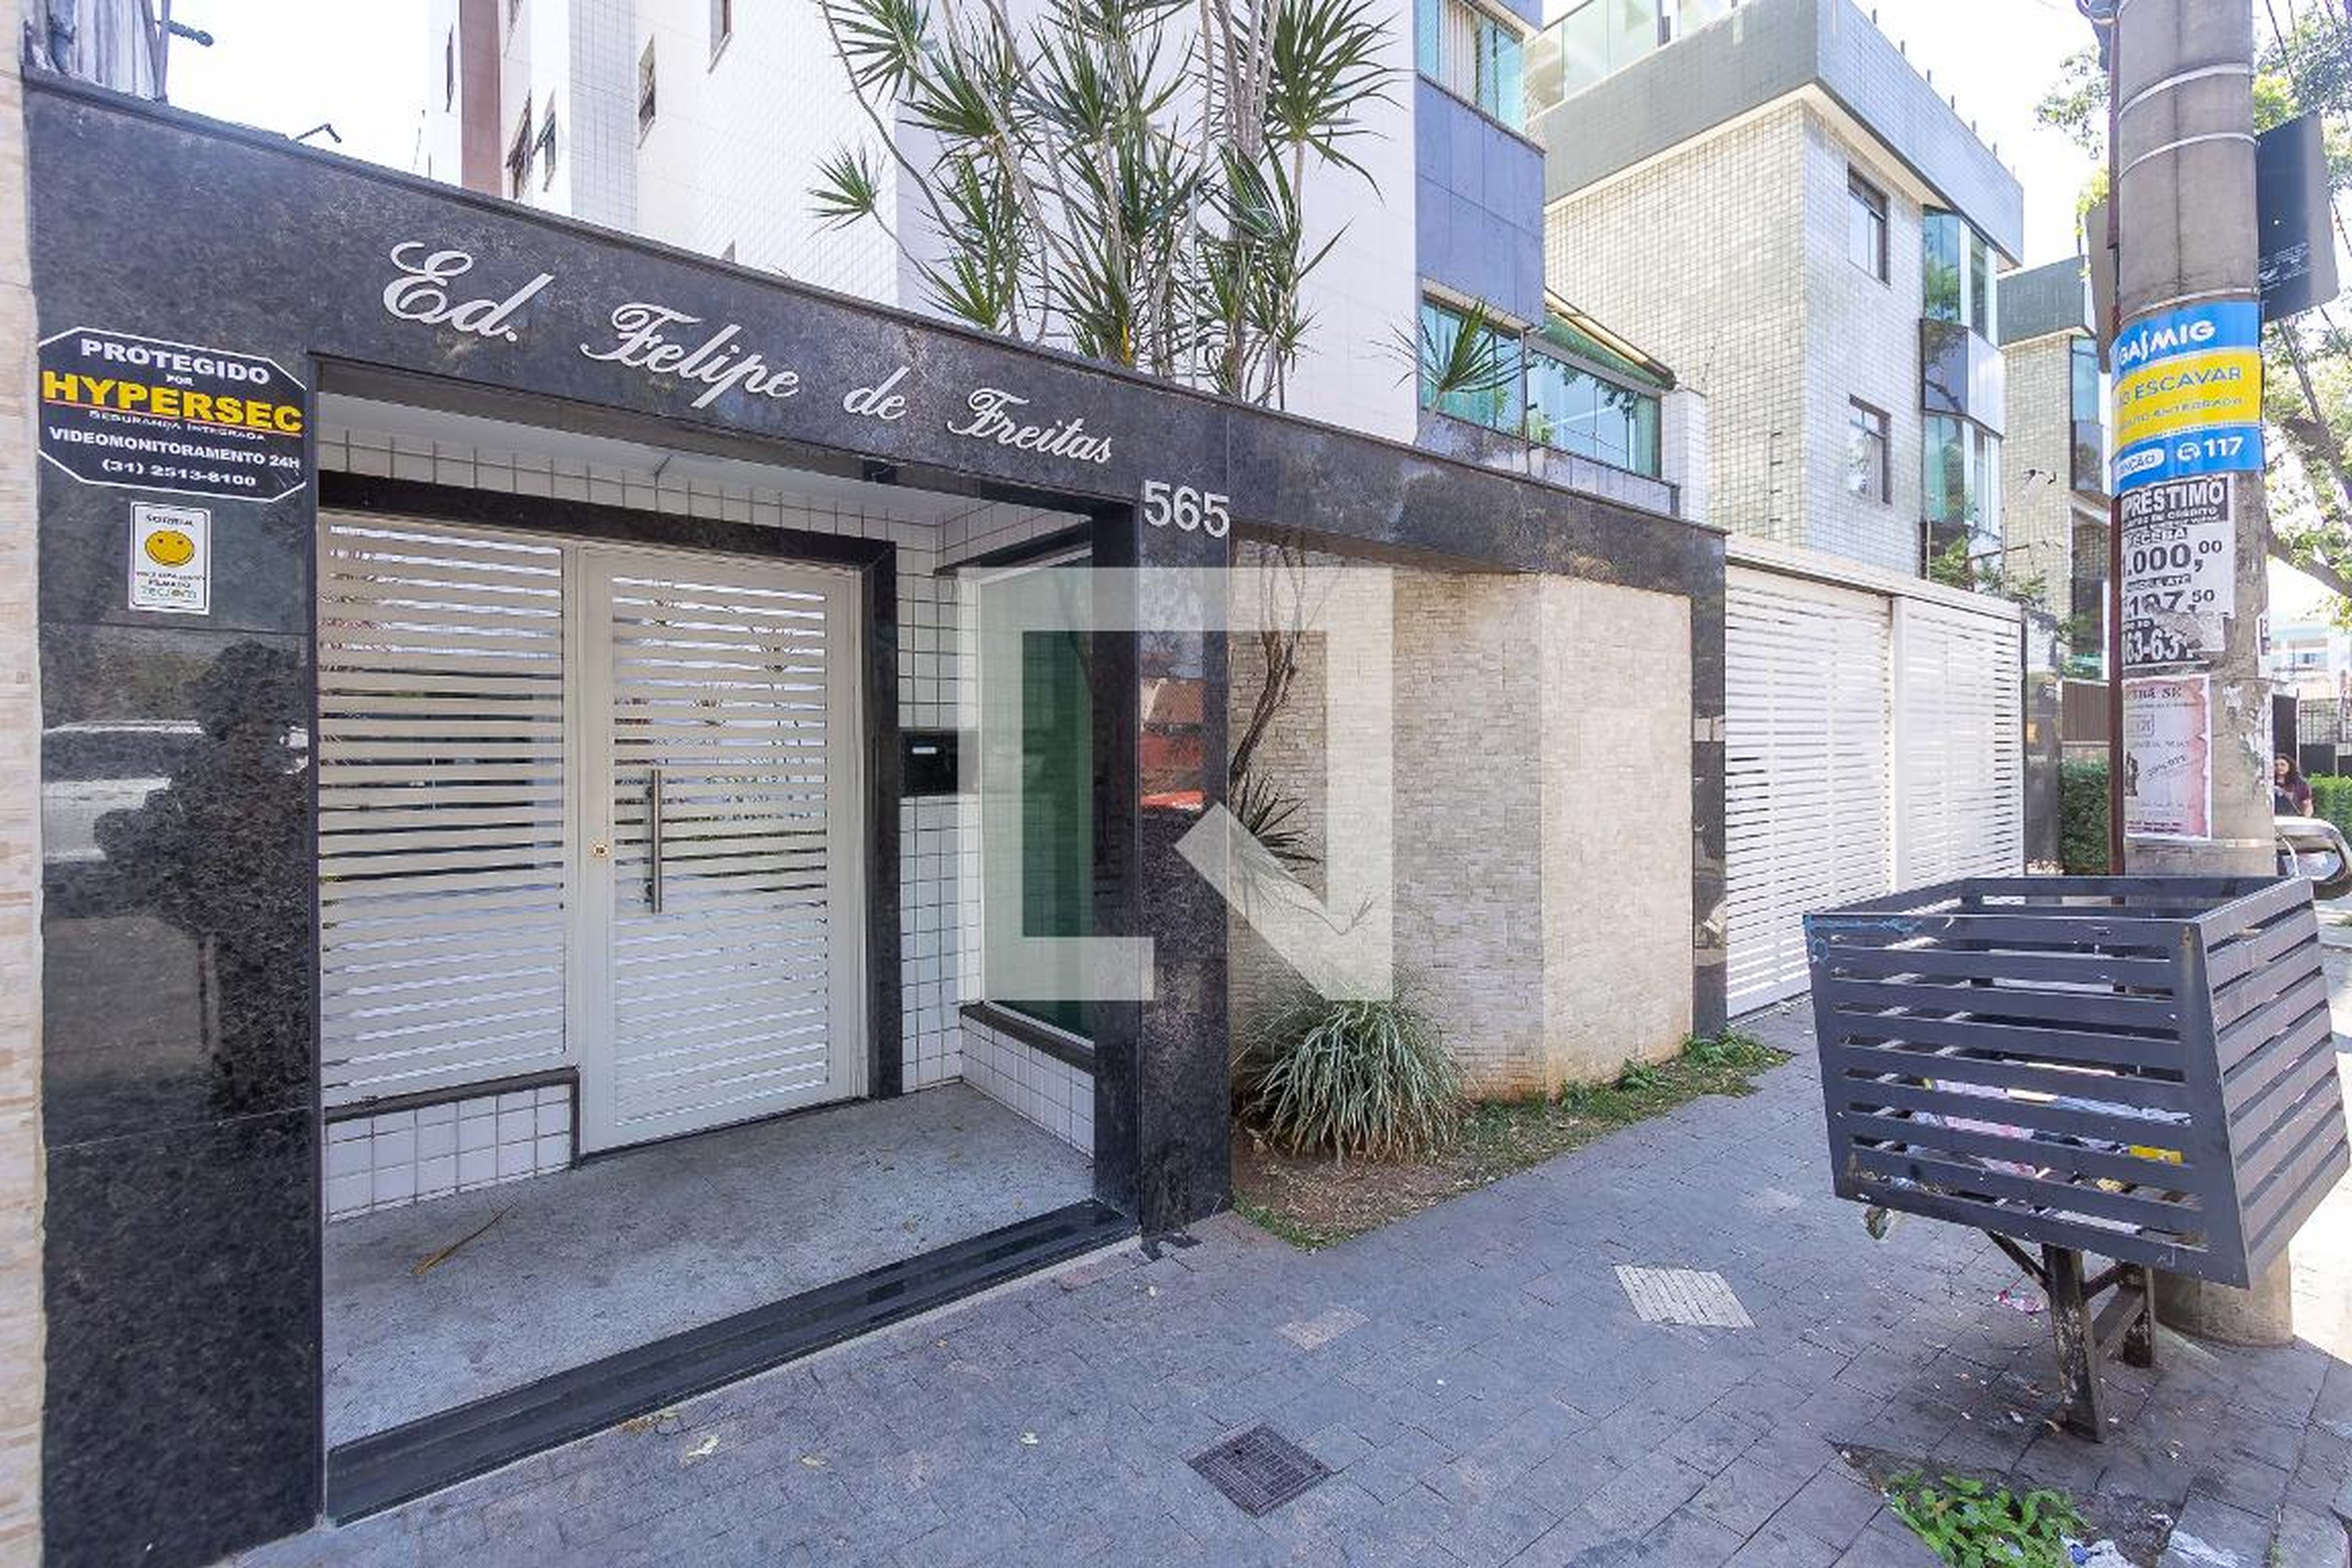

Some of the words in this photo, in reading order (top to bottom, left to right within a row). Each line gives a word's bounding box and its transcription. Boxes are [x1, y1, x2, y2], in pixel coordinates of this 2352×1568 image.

[81, 339, 270, 385] PROTEGIDO
[383, 243, 554, 341] Ed.
[579, 303, 799, 409] Felipe
[842, 367, 907, 420] de
[947, 388, 1112, 464] Freitas
[165, 374, 195, 386] POR
[2135, 367, 2242, 400] ESCAVAR
[43, 371, 303, 432] HYPERSEC
[50, 426, 266, 465] VIDEOMONITORAMENTO
[269, 454, 301, 469] 24H
[187, 423, 265, 441] INTEGRADA
[2204, 436, 2243, 458] 117
[101, 458, 145, 475] (31)
[150, 464, 257, 486] 2513-8100
[1144, 479, 1230, 538] 565
